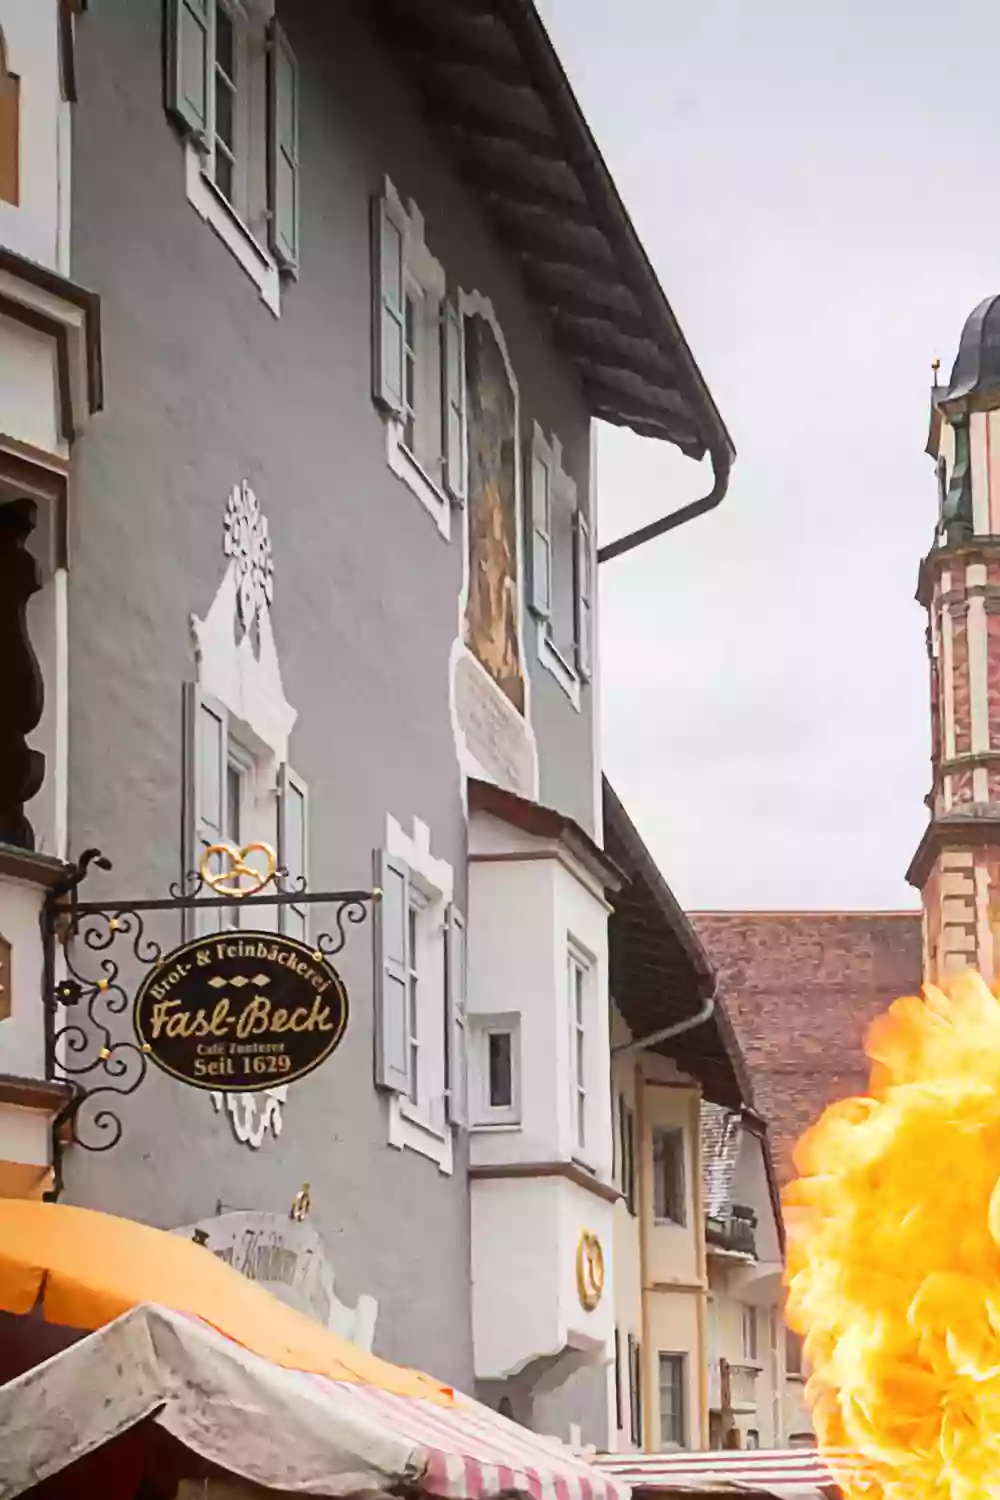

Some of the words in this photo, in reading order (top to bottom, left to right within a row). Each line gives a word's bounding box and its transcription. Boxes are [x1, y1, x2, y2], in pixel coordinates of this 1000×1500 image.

[150, 963, 192, 1000] Brot-
[196, 950, 212, 966] &
[217, 940, 332, 992] Feinbäckerei
[150, 995, 334, 1039] Fasl-Beck
[193, 1056, 235, 1076] Seit
[243, 1054, 292, 1074] 1629
